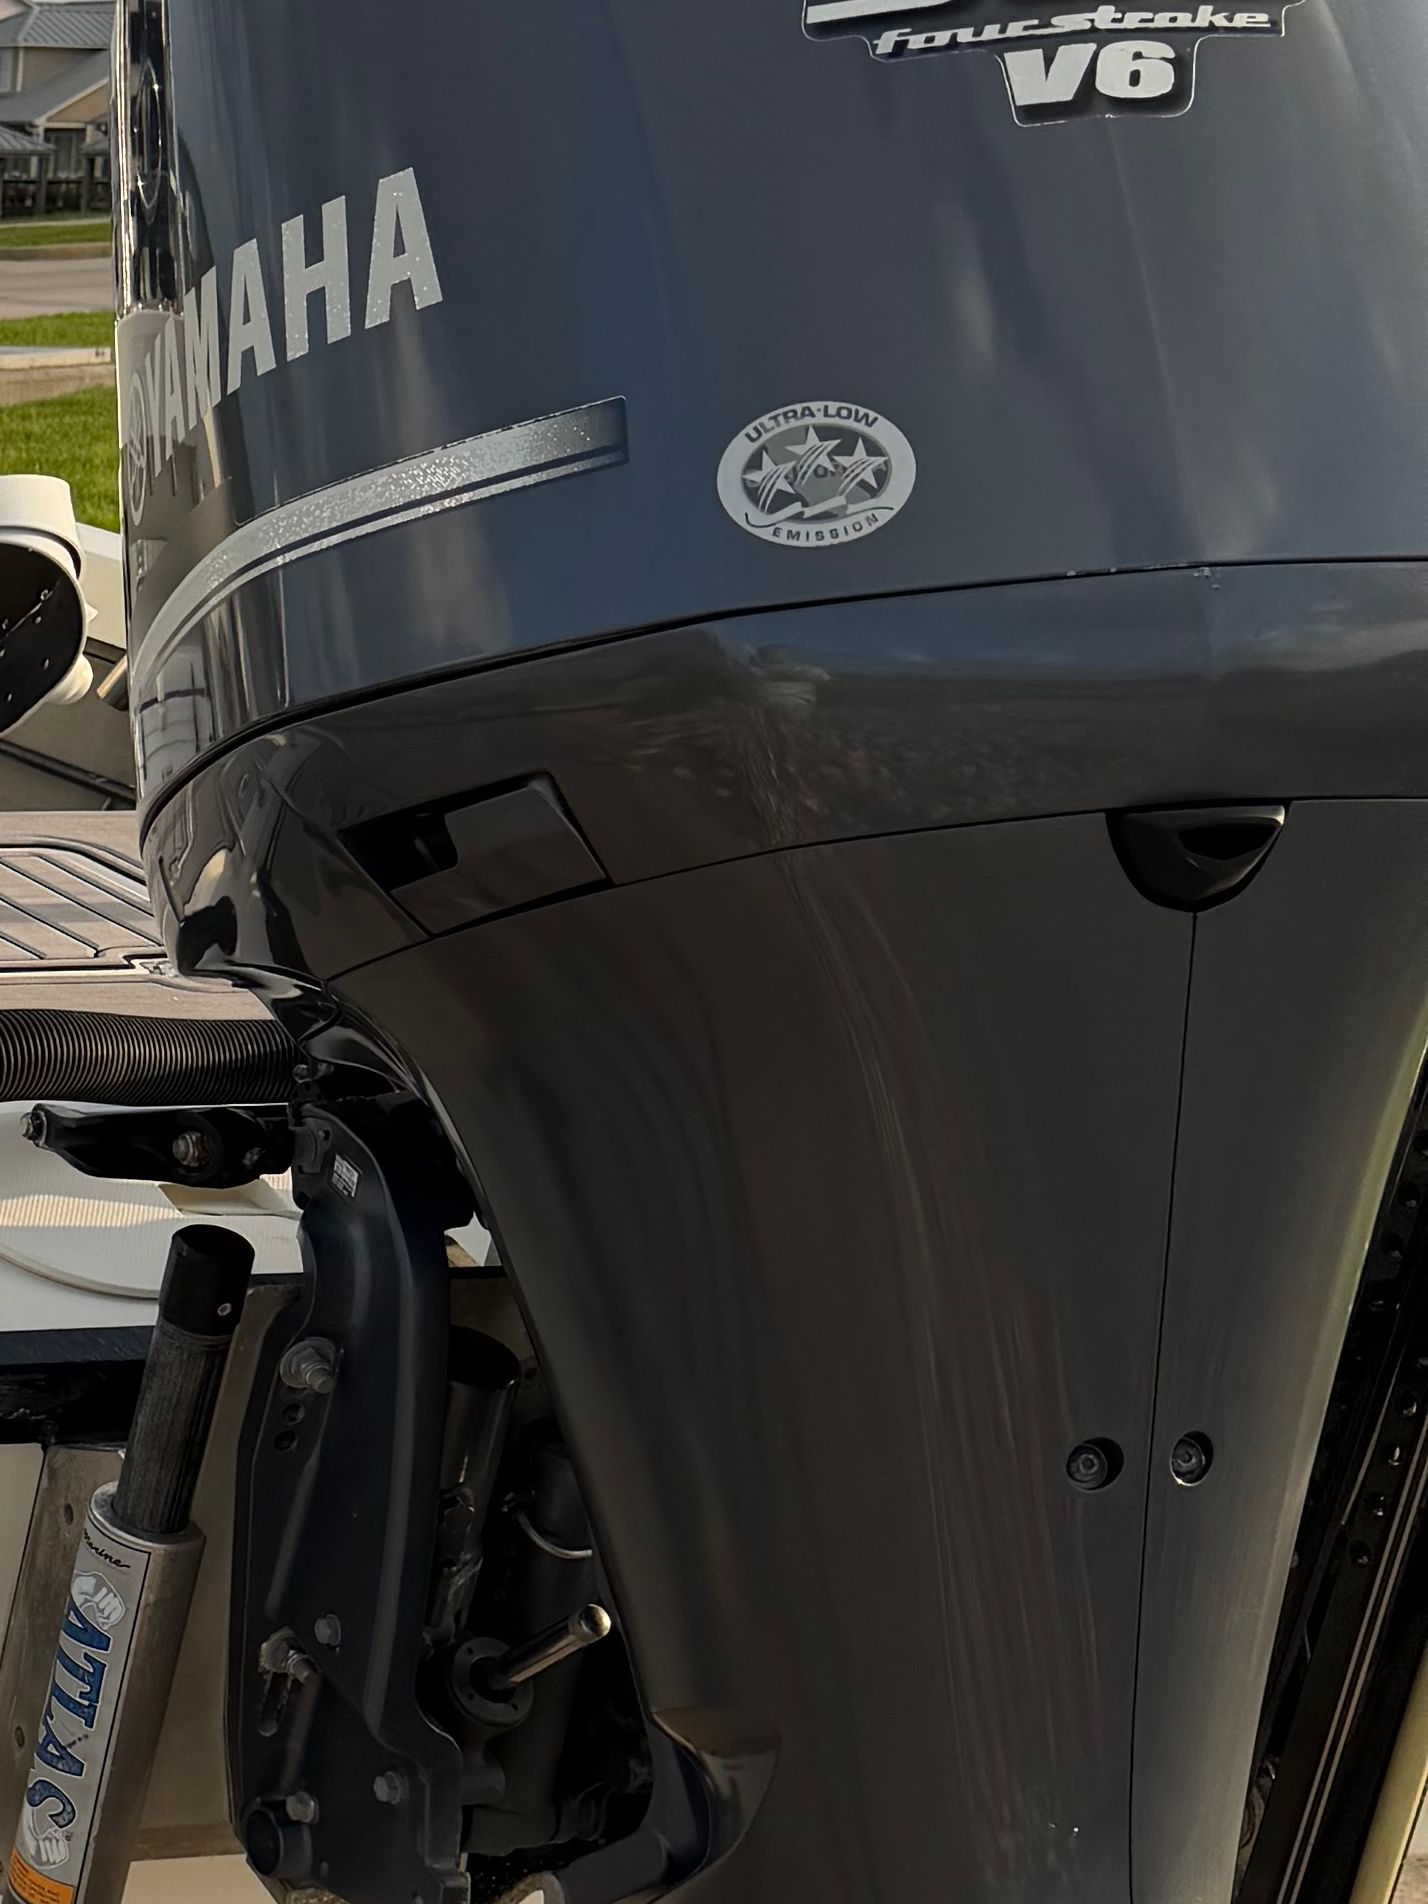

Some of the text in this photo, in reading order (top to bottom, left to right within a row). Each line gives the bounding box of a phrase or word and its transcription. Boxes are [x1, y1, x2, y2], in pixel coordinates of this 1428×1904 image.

[1004, 40, 1177, 106] V6
[144, 167, 443, 478] YAMAHA
[772, 513, 879, 542] EMISSION
[26, 1598, 112, 1829] ATLAS
